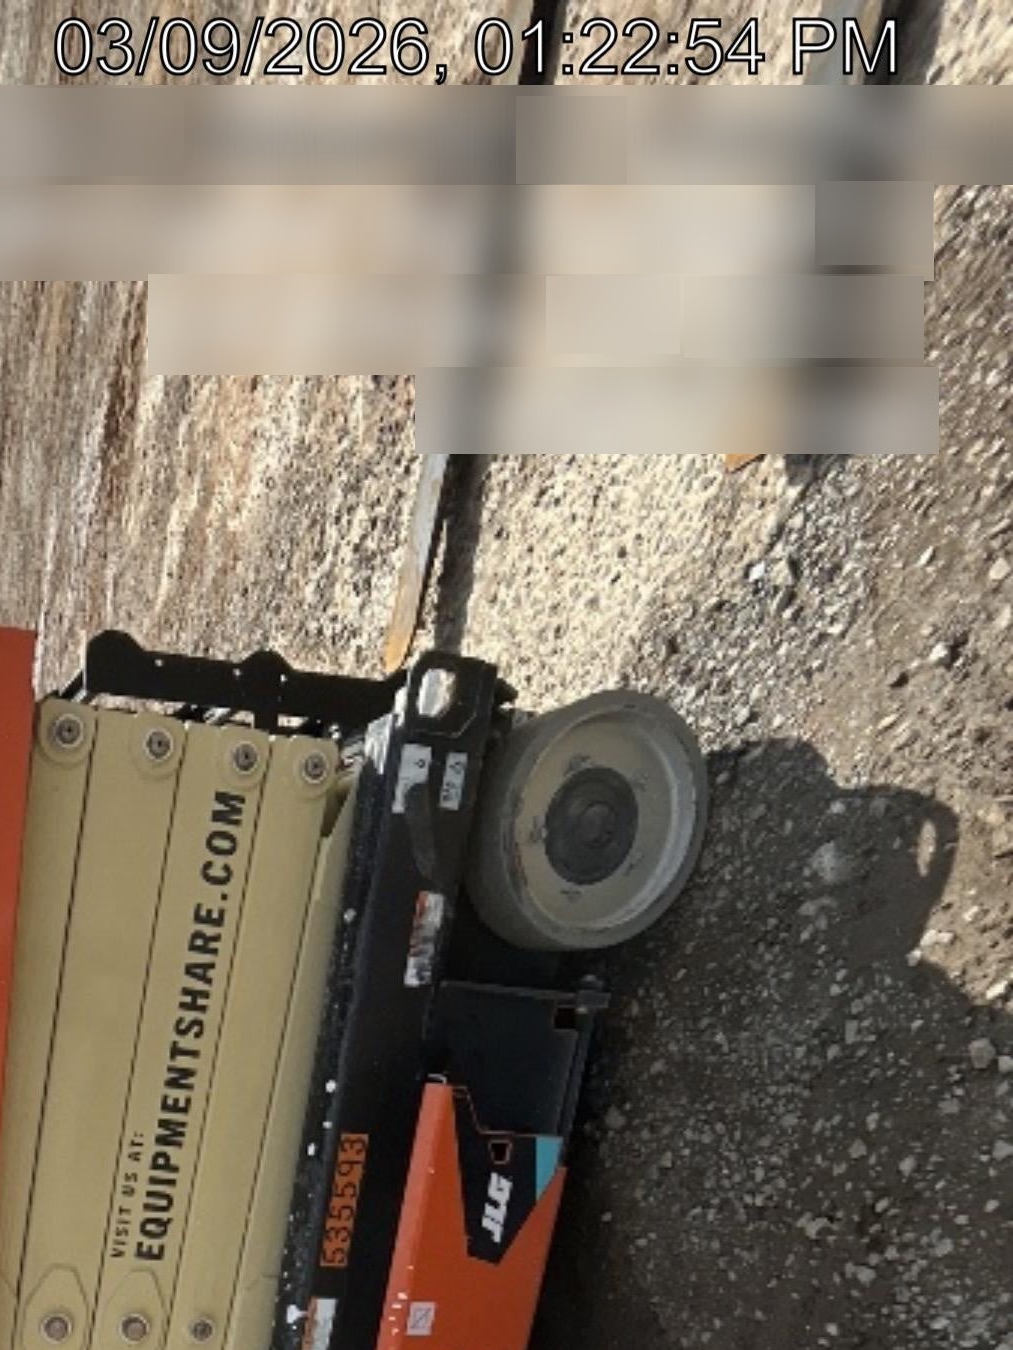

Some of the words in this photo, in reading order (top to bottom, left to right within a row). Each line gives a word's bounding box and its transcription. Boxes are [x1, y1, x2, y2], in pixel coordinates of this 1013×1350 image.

[135, 790, 246, 1262] EQUIPMENTSHARE.COM
[127, 1130, 145, 1163] AT:
[121, 1171, 139, 1198] US
[321, 1136, 368, 1265] 535593
[481, 1171, 513, 1243] JLG
[110, 1206, 133, 1258] VISIT
